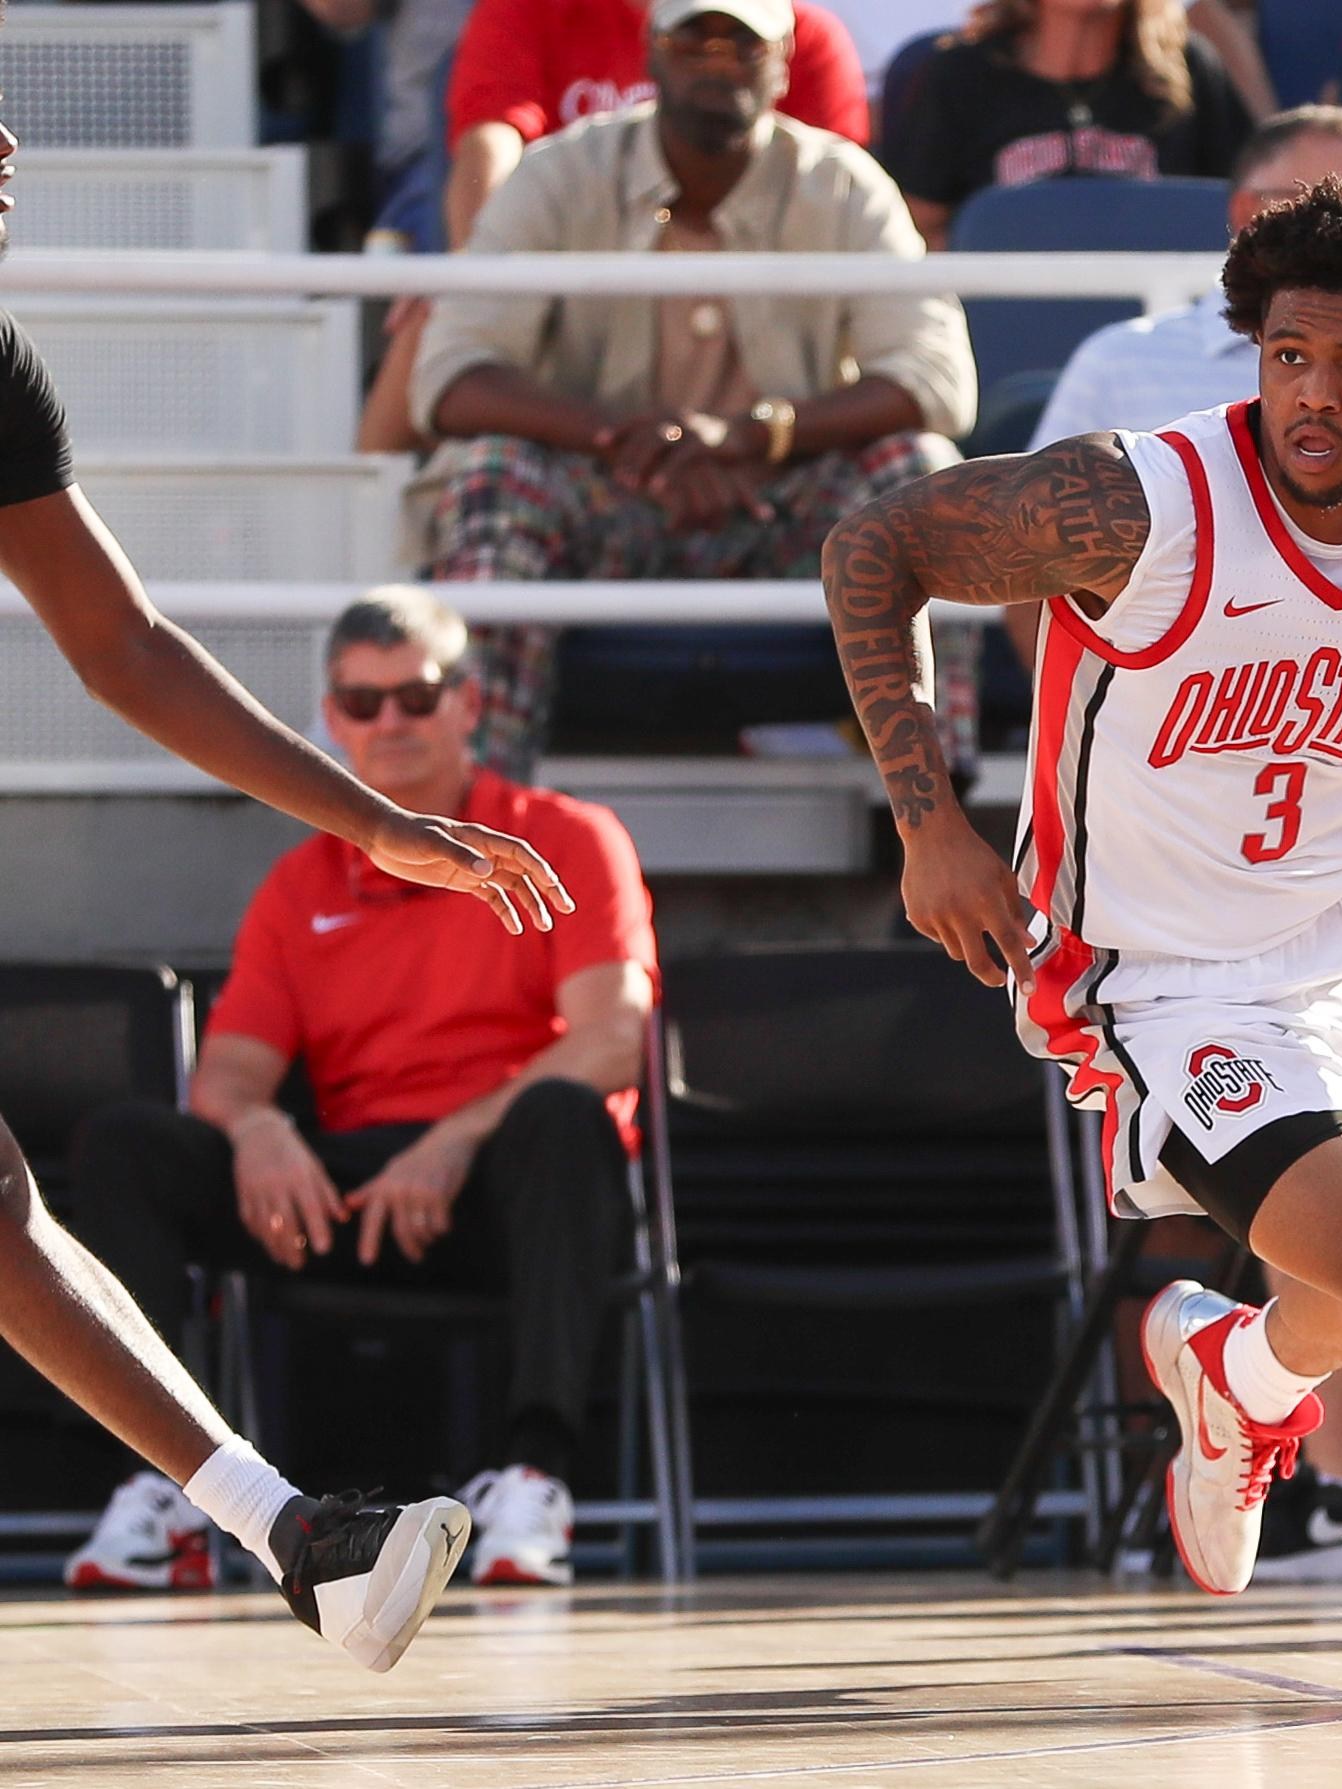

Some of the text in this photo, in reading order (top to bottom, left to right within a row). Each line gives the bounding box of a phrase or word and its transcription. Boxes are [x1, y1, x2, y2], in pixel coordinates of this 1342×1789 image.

[1044, 447, 1112, 561] FAITH
[841, 628, 931, 779] FIRST
[1147, 660, 1299, 769] OHIO
[1240, 762, 1308, 865] 3
[1184, 1059, 1285, 1131] OHIO STATE
